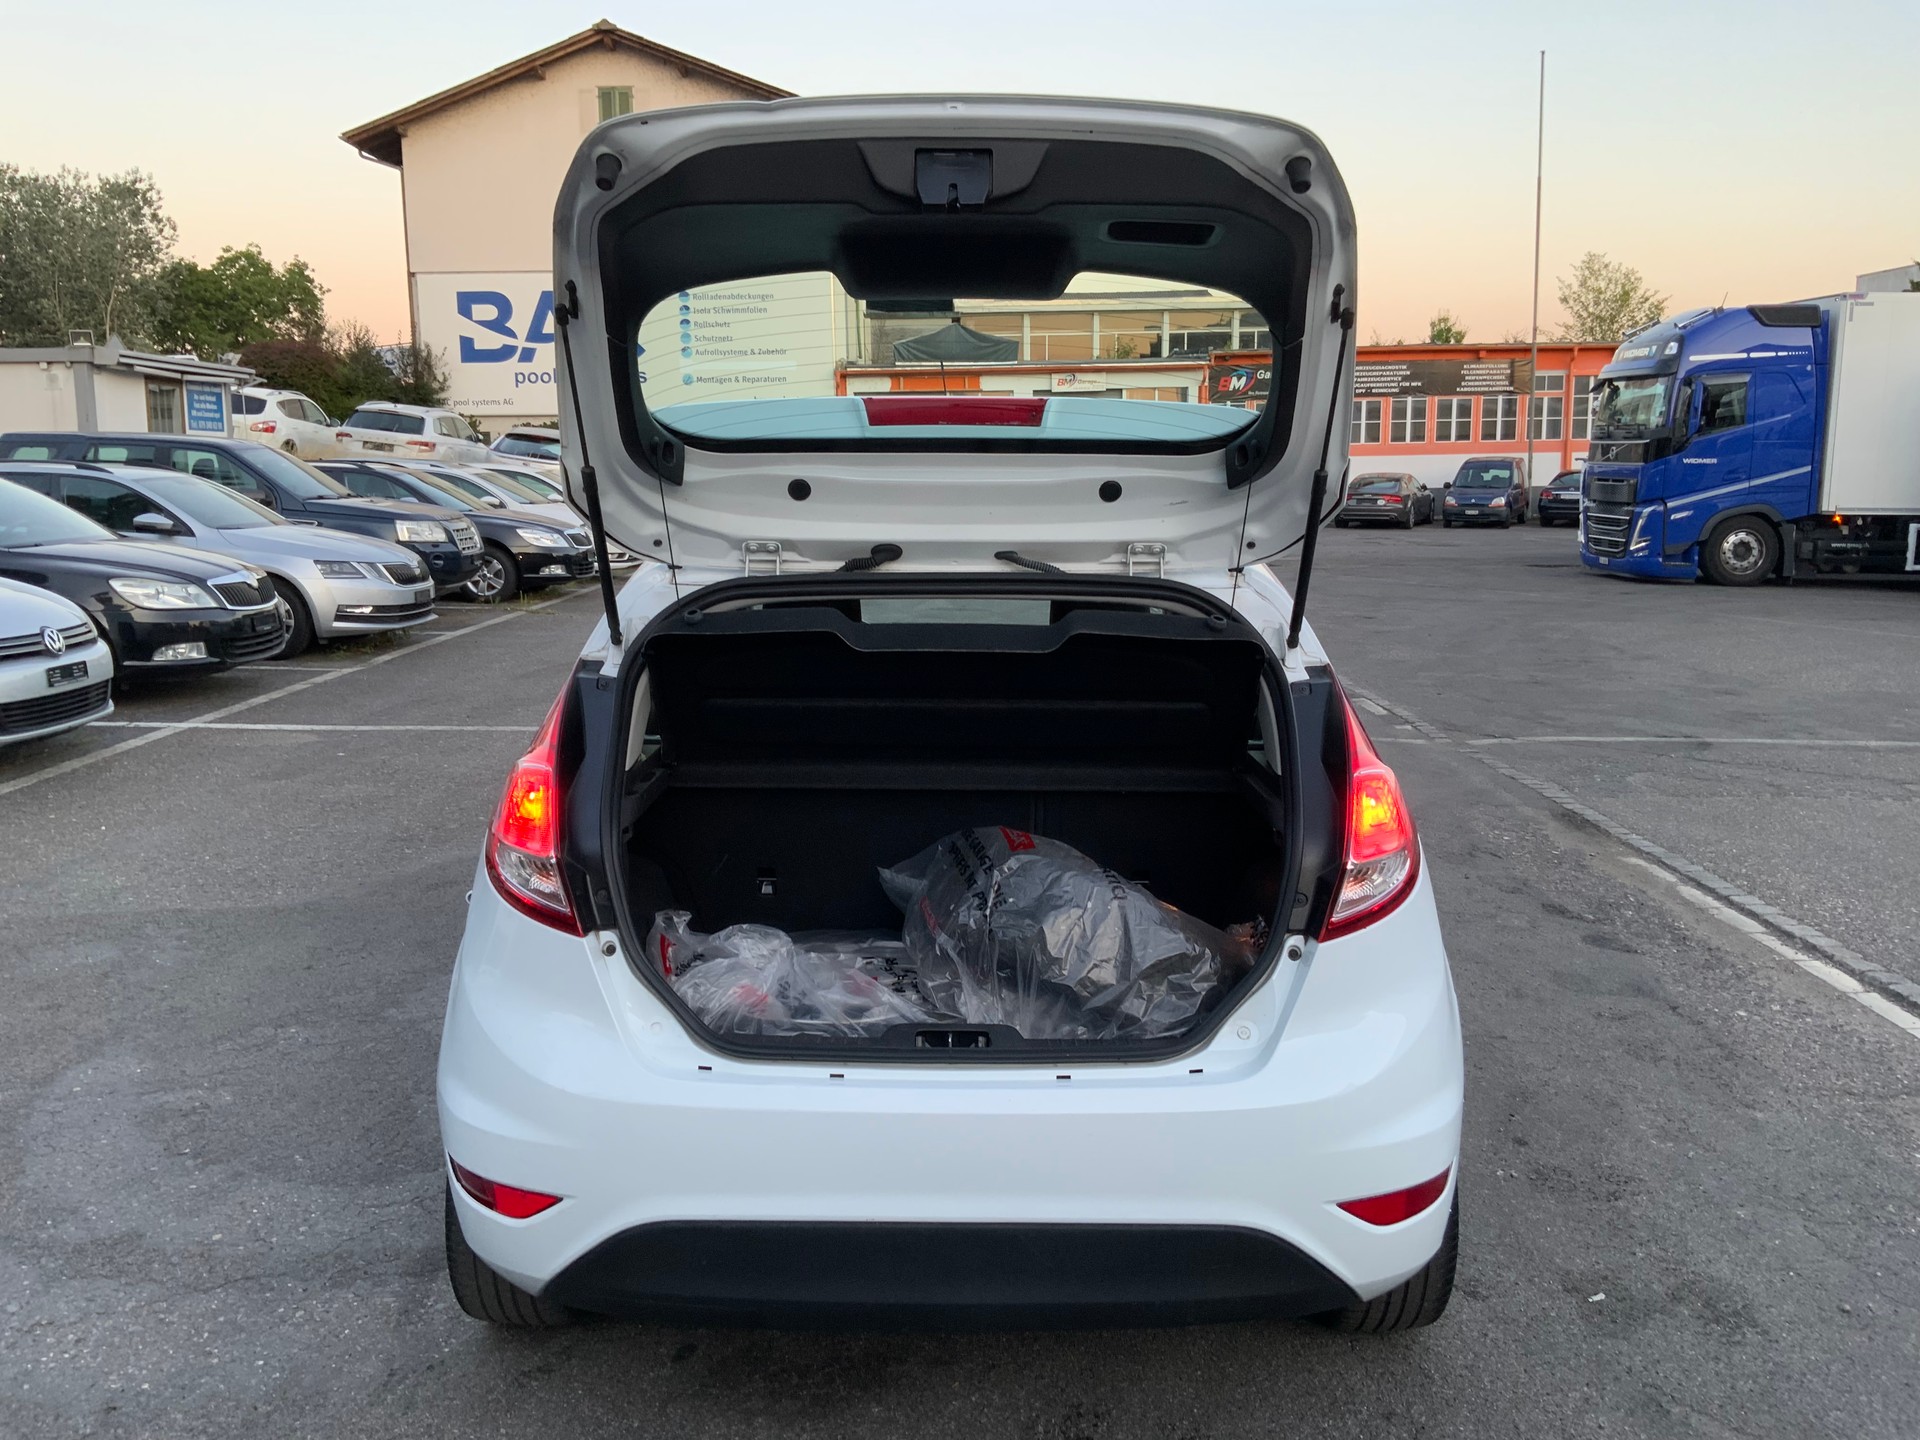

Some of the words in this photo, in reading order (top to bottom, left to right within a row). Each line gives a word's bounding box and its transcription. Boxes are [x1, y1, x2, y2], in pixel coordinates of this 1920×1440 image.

[713, 306, 768, 314] Schwimmfolien
[456, 290, 556, 363] BA
[1256, 370, 1271, 379] Ga
[742, 375, 787, 384] Reparaturen
[453, 398, 470, 408] pool
[471, 399, 501, 408] systems
[502, 398, 514, 406] AG
